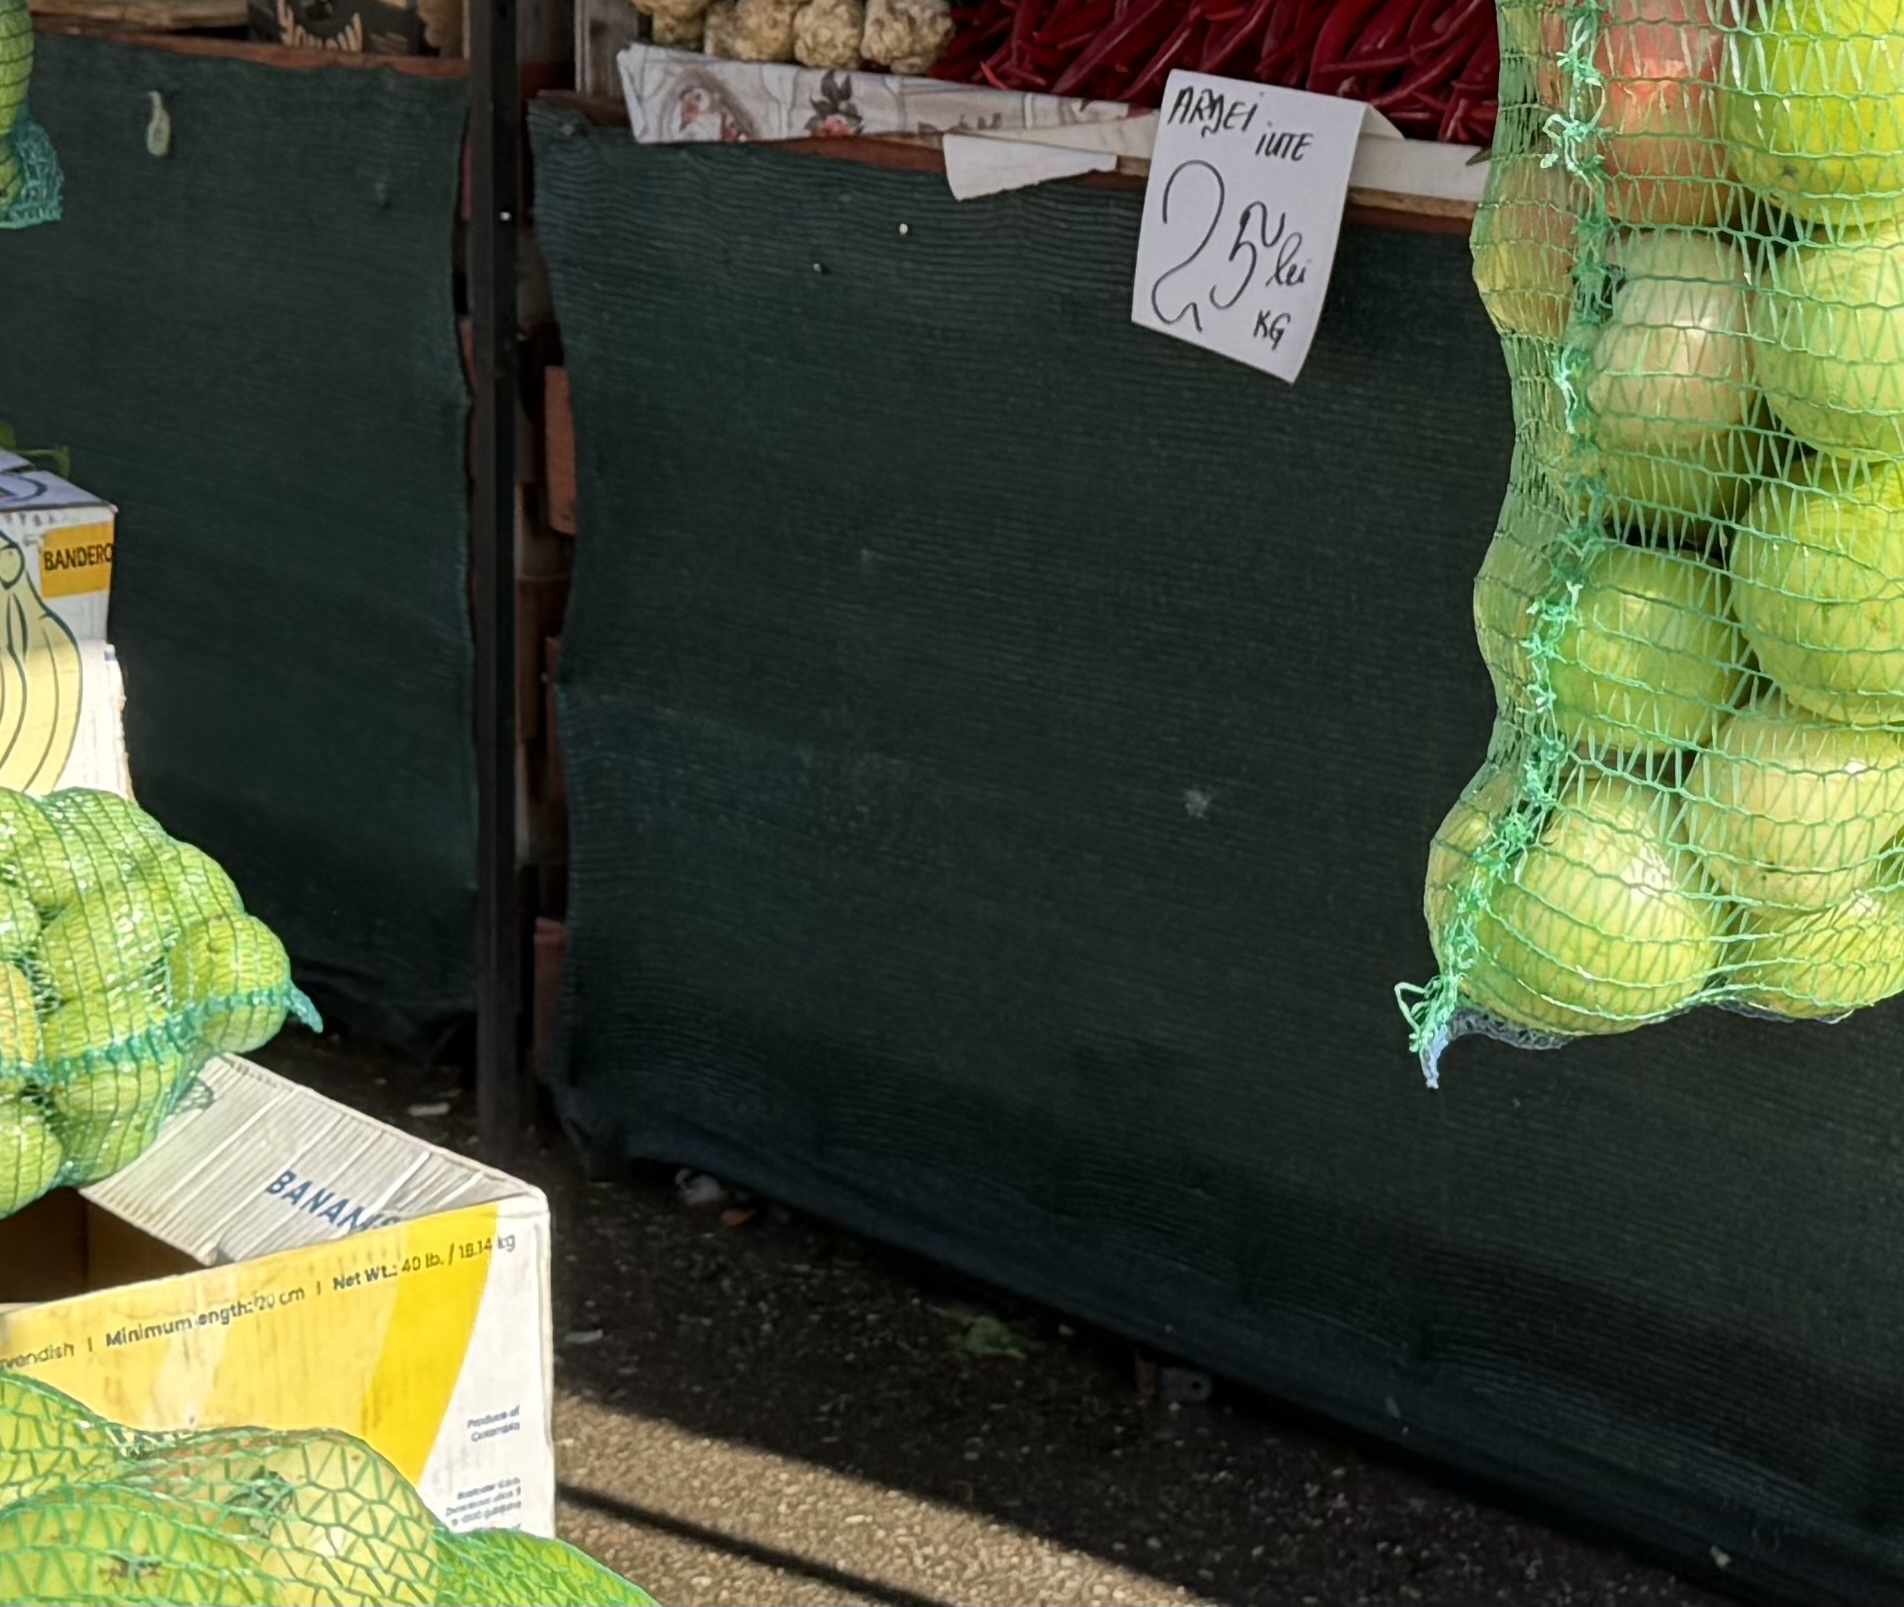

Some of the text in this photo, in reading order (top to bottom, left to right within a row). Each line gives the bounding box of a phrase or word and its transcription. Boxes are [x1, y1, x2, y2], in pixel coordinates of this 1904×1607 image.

[1253, 308, 1291, 351] KG
[265, 1169, 400, 1232] BANAN
[105, 1316, 193, 1348] Minimum
[194, 1300, 254, 1326] ength:
[279, 1286, 306, 1306] cm
[332, 1272, 361, 1292] Net
[400, 1254, 422, 1273] 40
